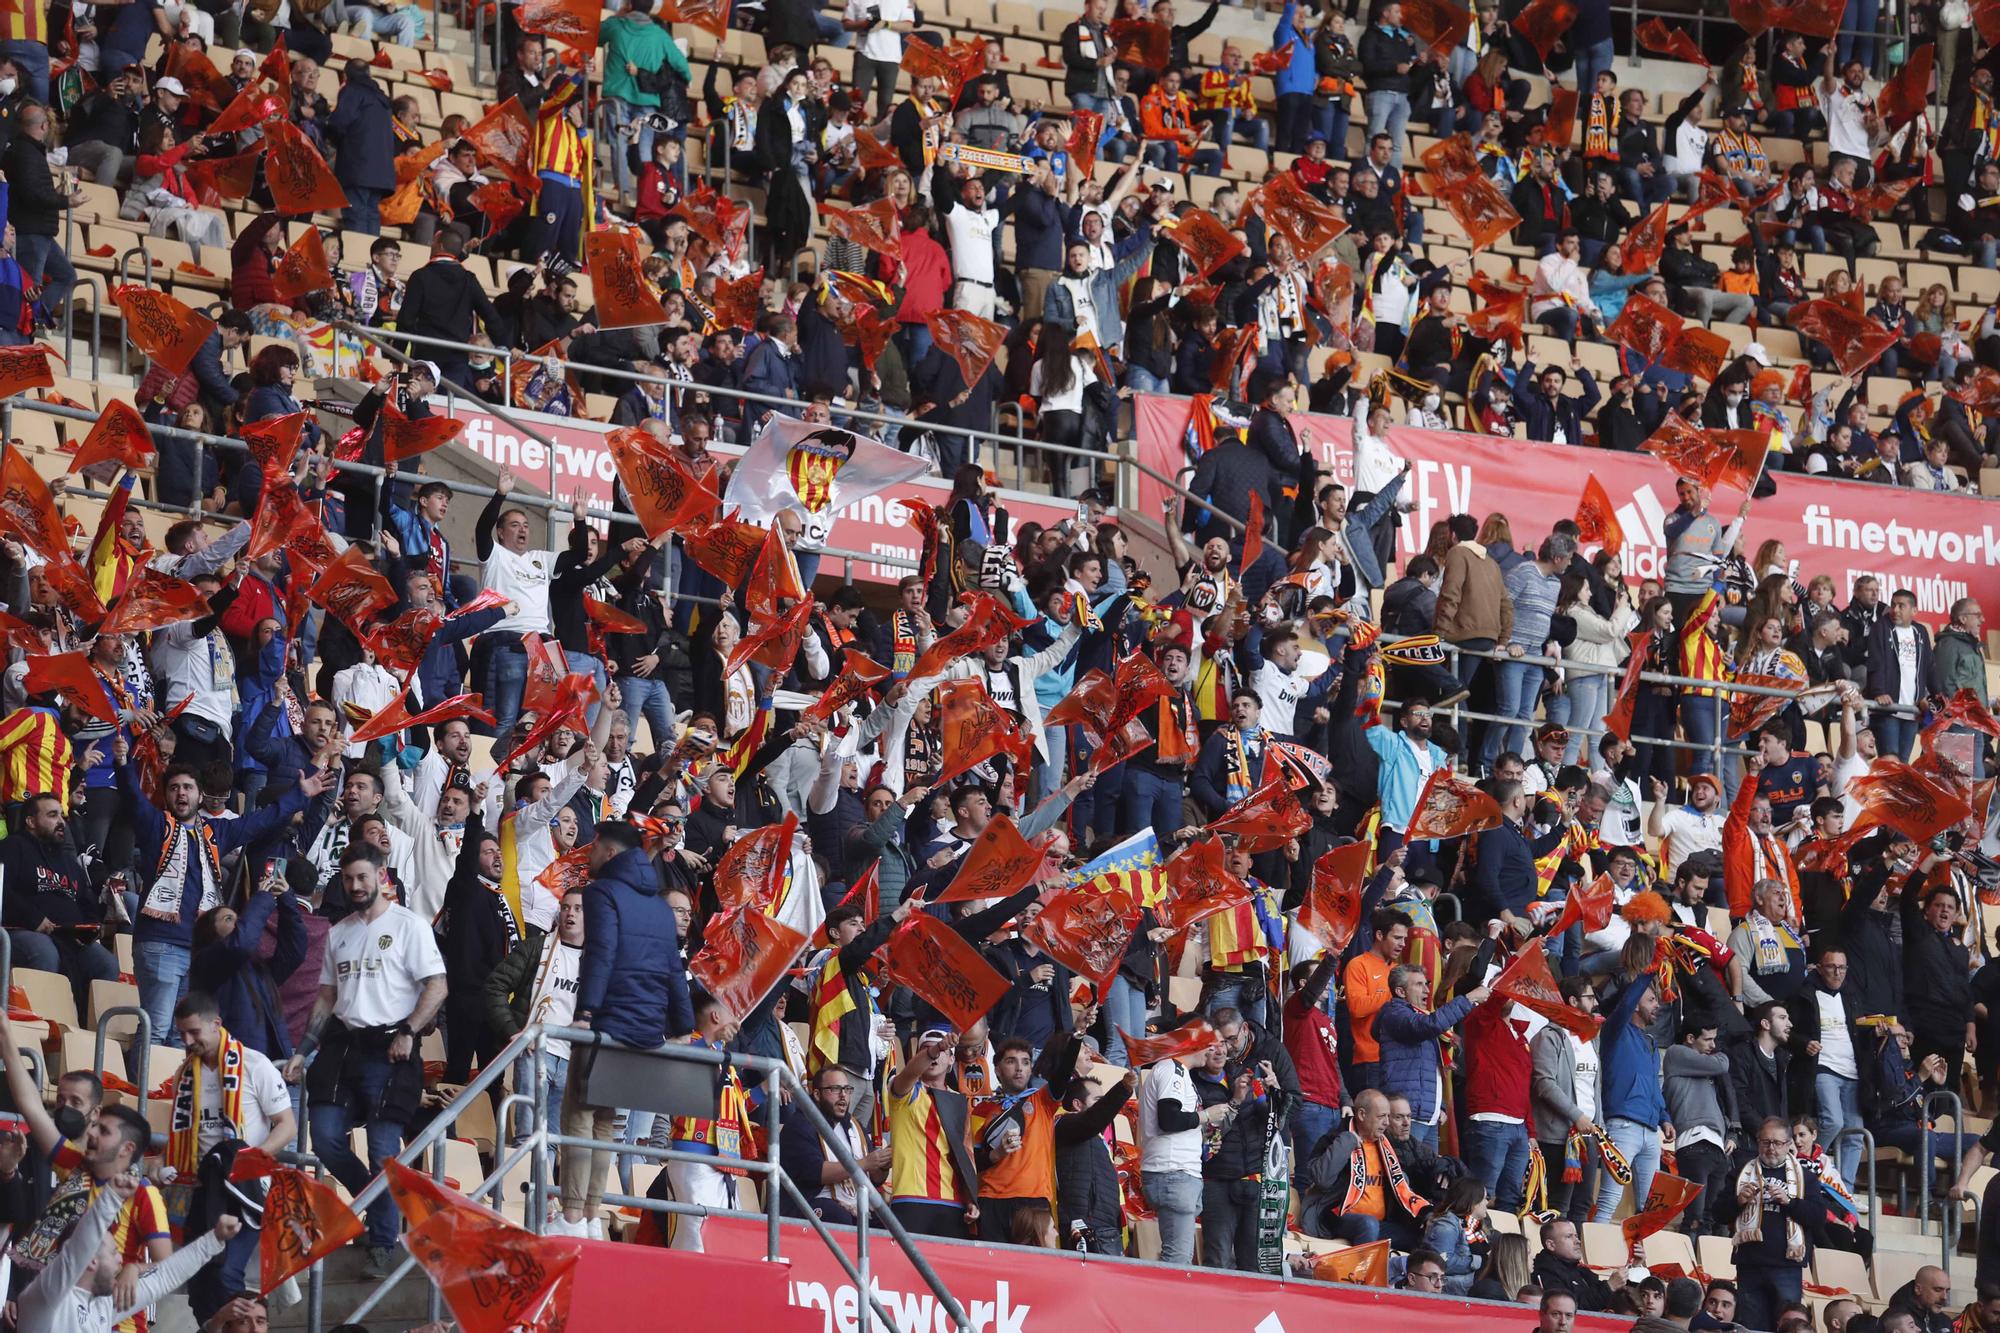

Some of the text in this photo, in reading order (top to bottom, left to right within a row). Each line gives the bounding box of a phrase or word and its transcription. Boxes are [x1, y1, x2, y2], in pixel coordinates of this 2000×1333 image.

[1802, 504, 2000, 566] finetwork
[1846, 568, 1896, 607] FRA
[1263, 1181, 1280, 1246] BETIS
[771, 1256, 1031, 1333] network
